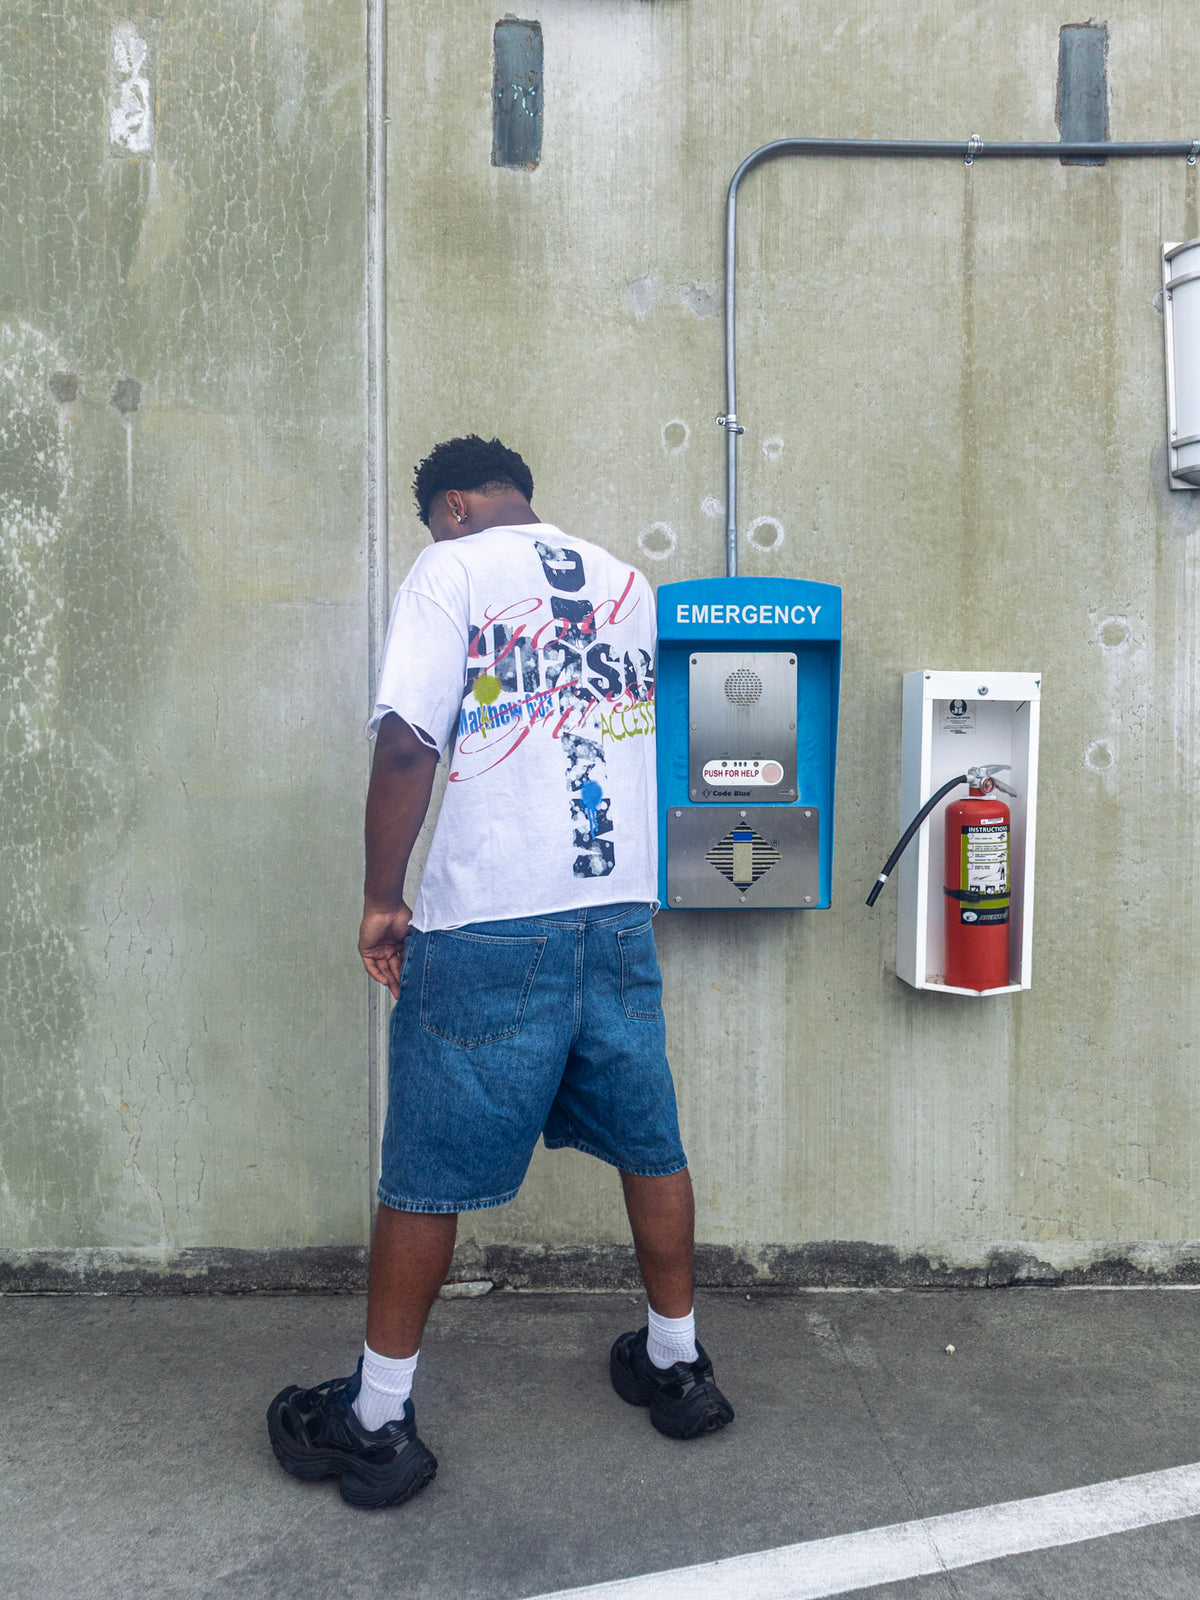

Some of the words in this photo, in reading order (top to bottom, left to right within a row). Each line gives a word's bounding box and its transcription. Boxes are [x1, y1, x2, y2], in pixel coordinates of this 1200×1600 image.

[676, 604, 822, 625] EMERGENCY
[465, 572, 640, 683] God
[704, 769, 723, 778] PUSH
[725, 769, 740, 778] FOR
[741, 769, 760, 778] HELP
[968, 825, 1008, 833] INSTRUCTIONS
